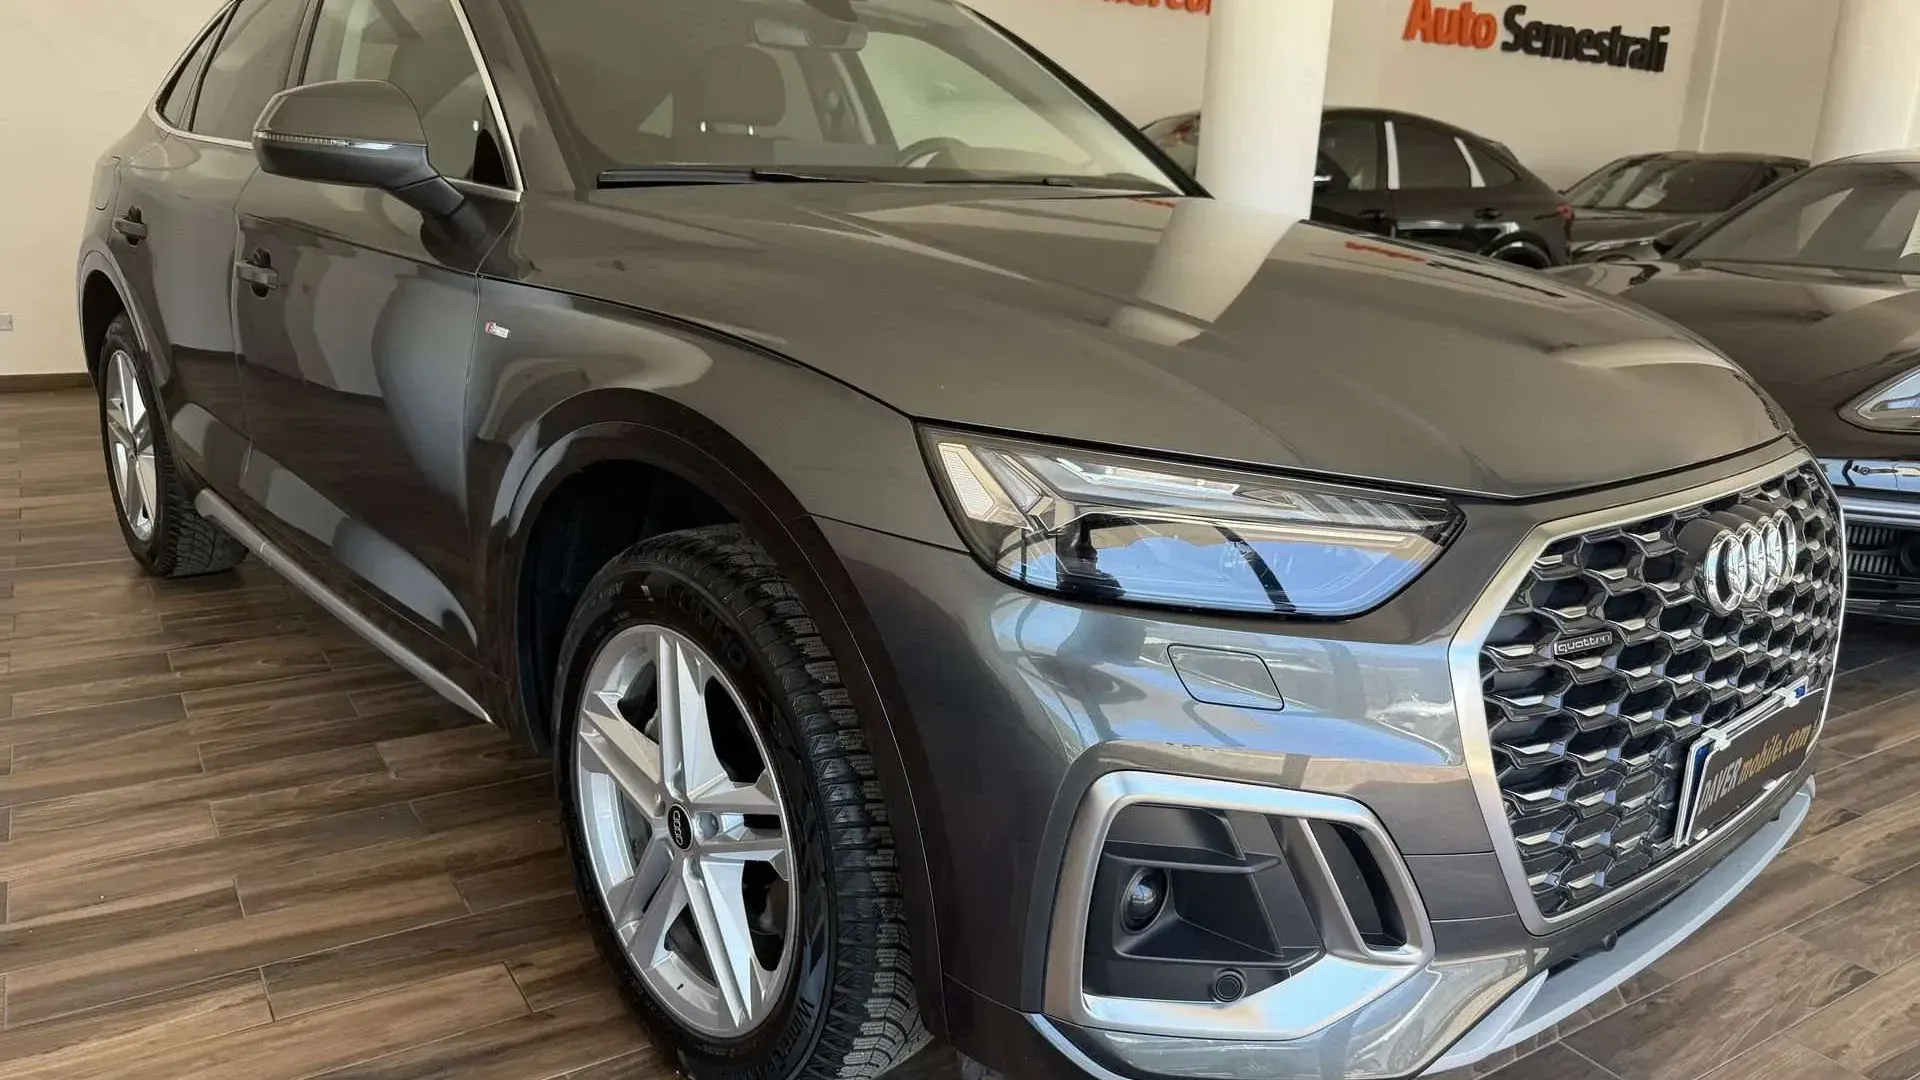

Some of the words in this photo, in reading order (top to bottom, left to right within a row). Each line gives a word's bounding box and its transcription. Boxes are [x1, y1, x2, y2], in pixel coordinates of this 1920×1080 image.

[1402, 0, 1498, 49] Auto
[1500, 4, 1671, 73] Semestrali
[1557, 633, 1612, 654] quattro
